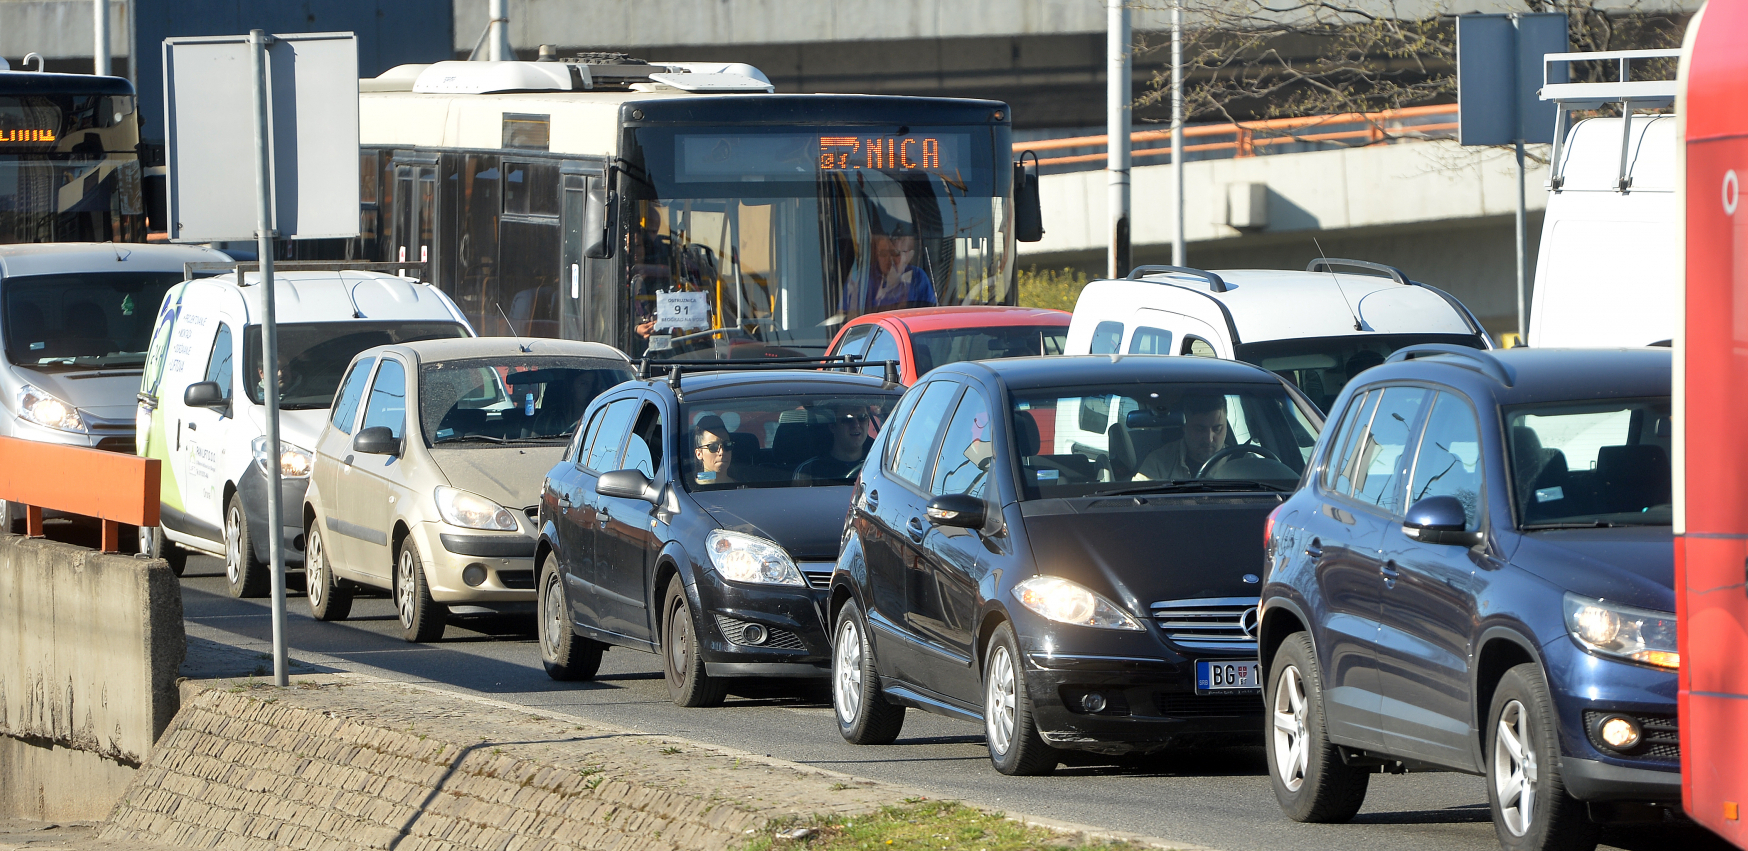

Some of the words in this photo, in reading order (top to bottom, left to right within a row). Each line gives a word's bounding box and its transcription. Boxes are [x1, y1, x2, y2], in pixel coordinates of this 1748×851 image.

[866, 138, 939, 169] NICA
[674, 305, 689, 315] 91
[1211, 664, 1235, 686] BG
